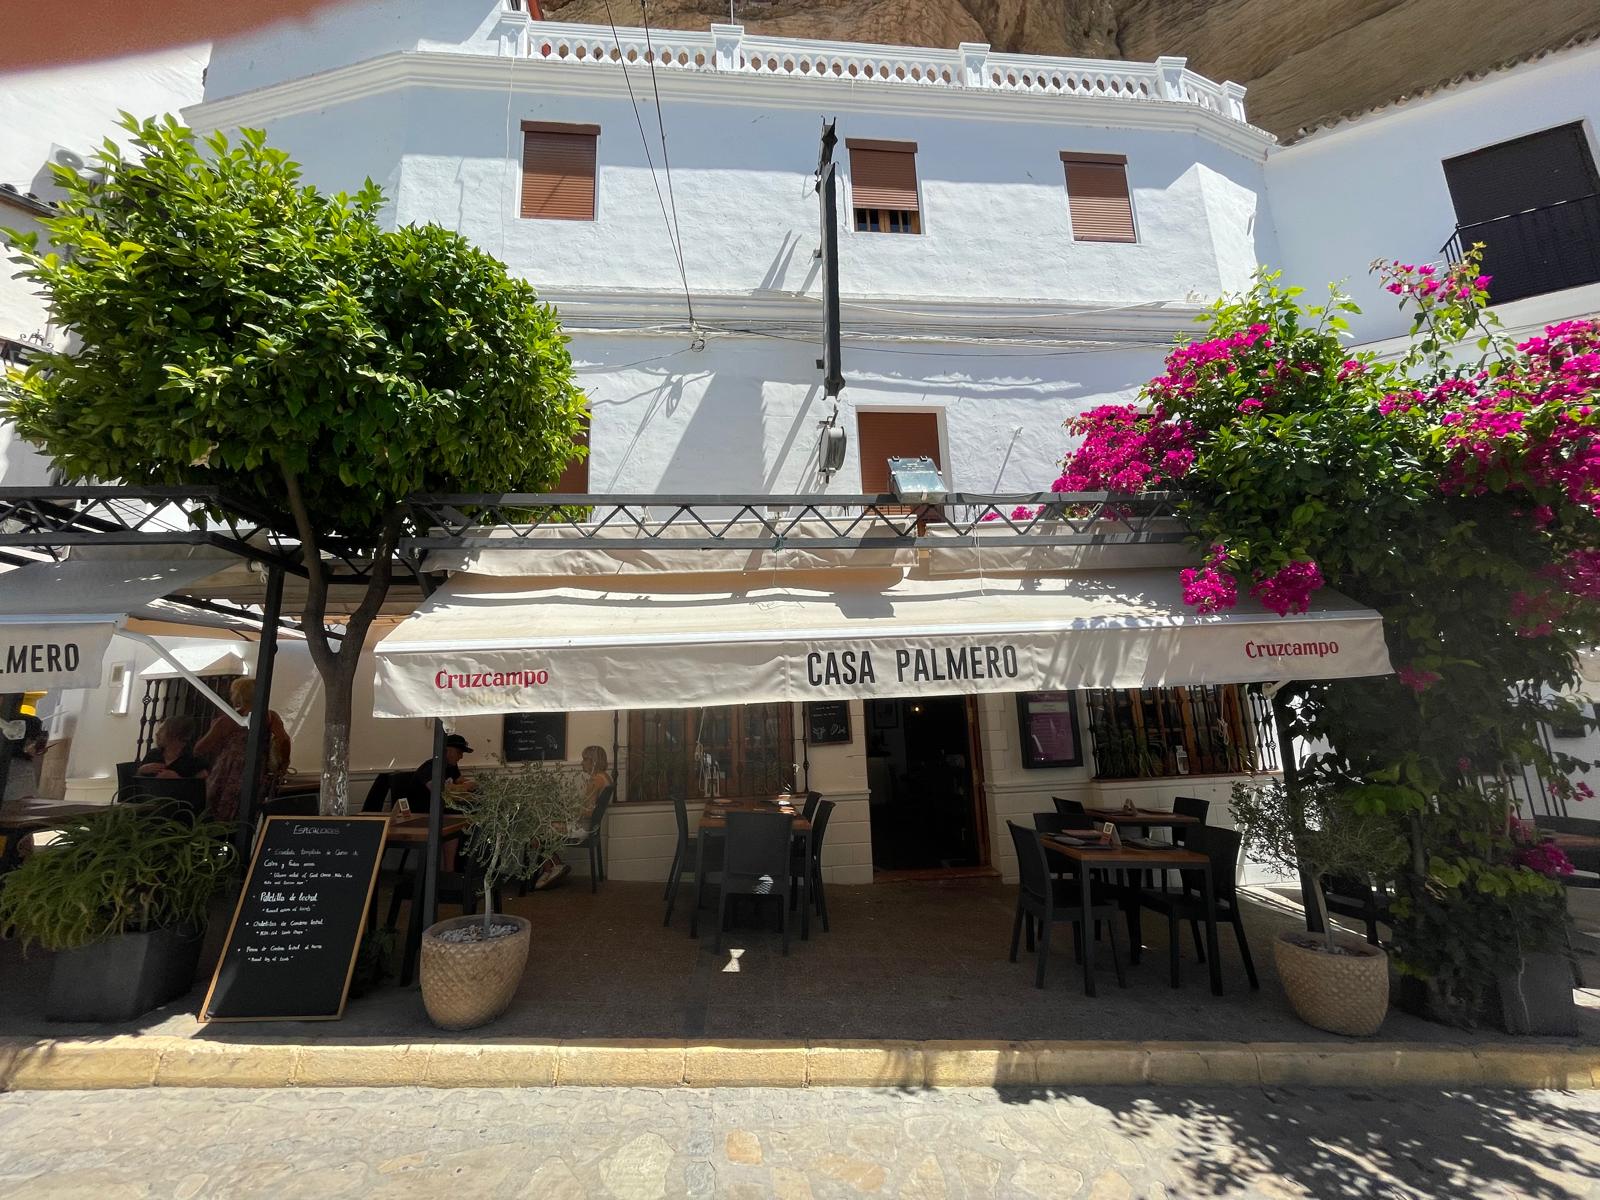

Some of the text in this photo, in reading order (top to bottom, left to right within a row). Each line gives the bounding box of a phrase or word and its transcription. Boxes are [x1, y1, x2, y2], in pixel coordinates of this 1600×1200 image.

[0, 643, 80, 674] MERO
[1245, 639, 1340, 659] Cruzcampo
[807, 645, 1018, 687] CASA PALMERO
[435, 669, 548, 689] Cruzcampo
[260, 892, 285, 902] Paletilla
[289, 892, 296, 902] de
